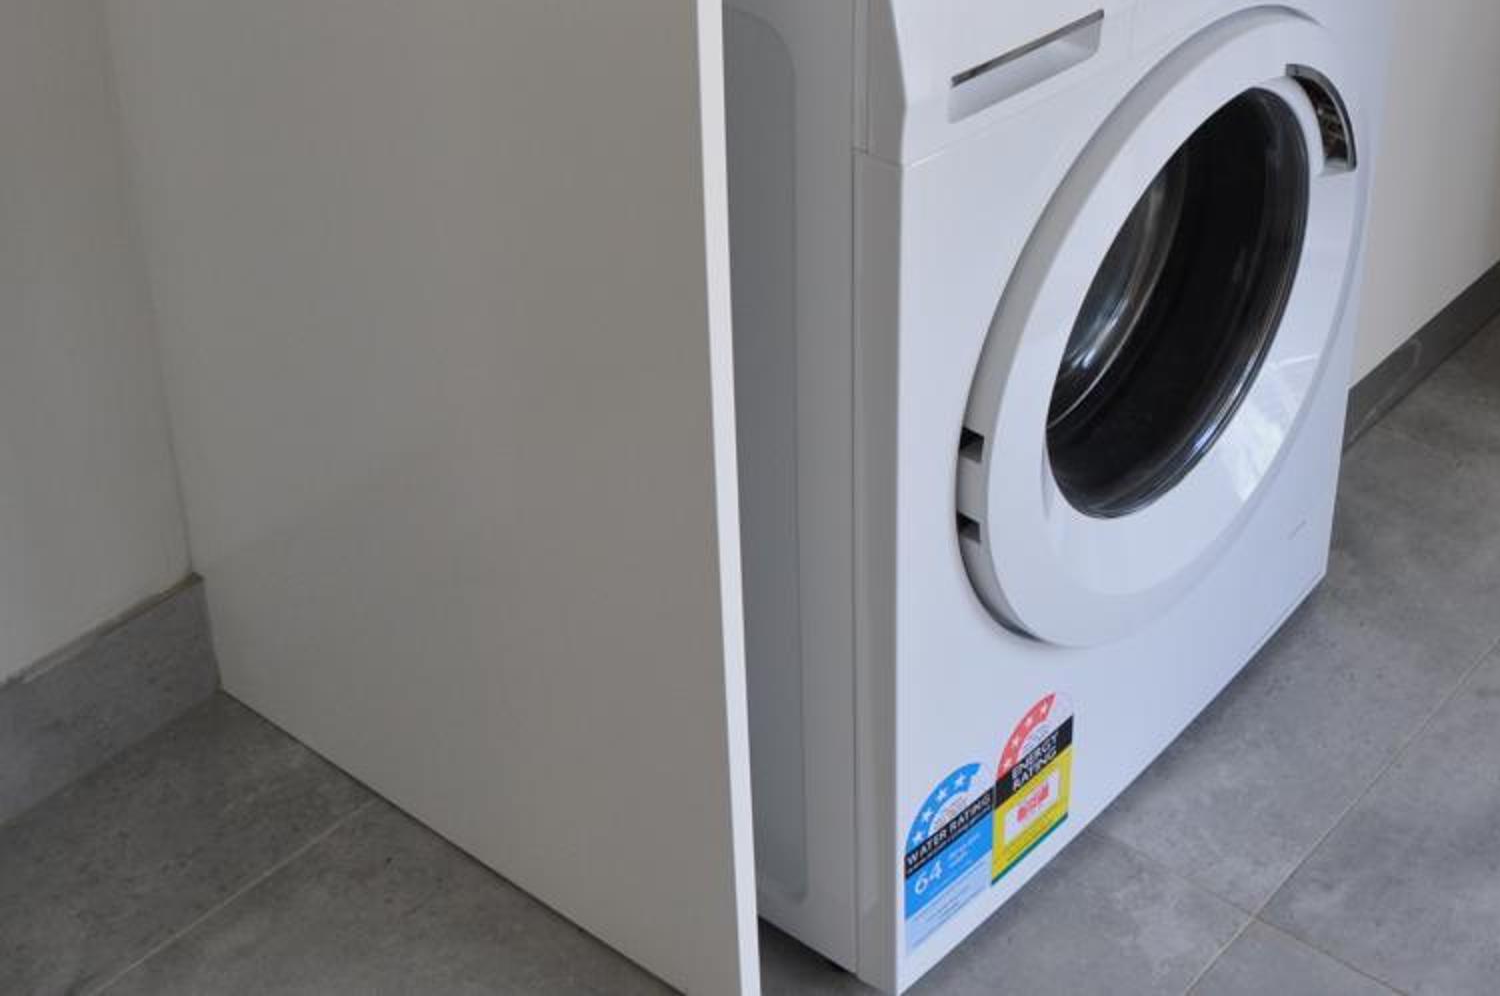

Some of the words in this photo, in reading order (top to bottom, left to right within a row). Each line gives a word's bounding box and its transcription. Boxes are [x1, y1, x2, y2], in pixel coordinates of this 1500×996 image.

[1011, 730, 1060, 780] ENERGY
[1012, 747, 1058, 792] RATING
[907, 825, 948, 867] WATER
[948, 793, 992, 836] RATING
